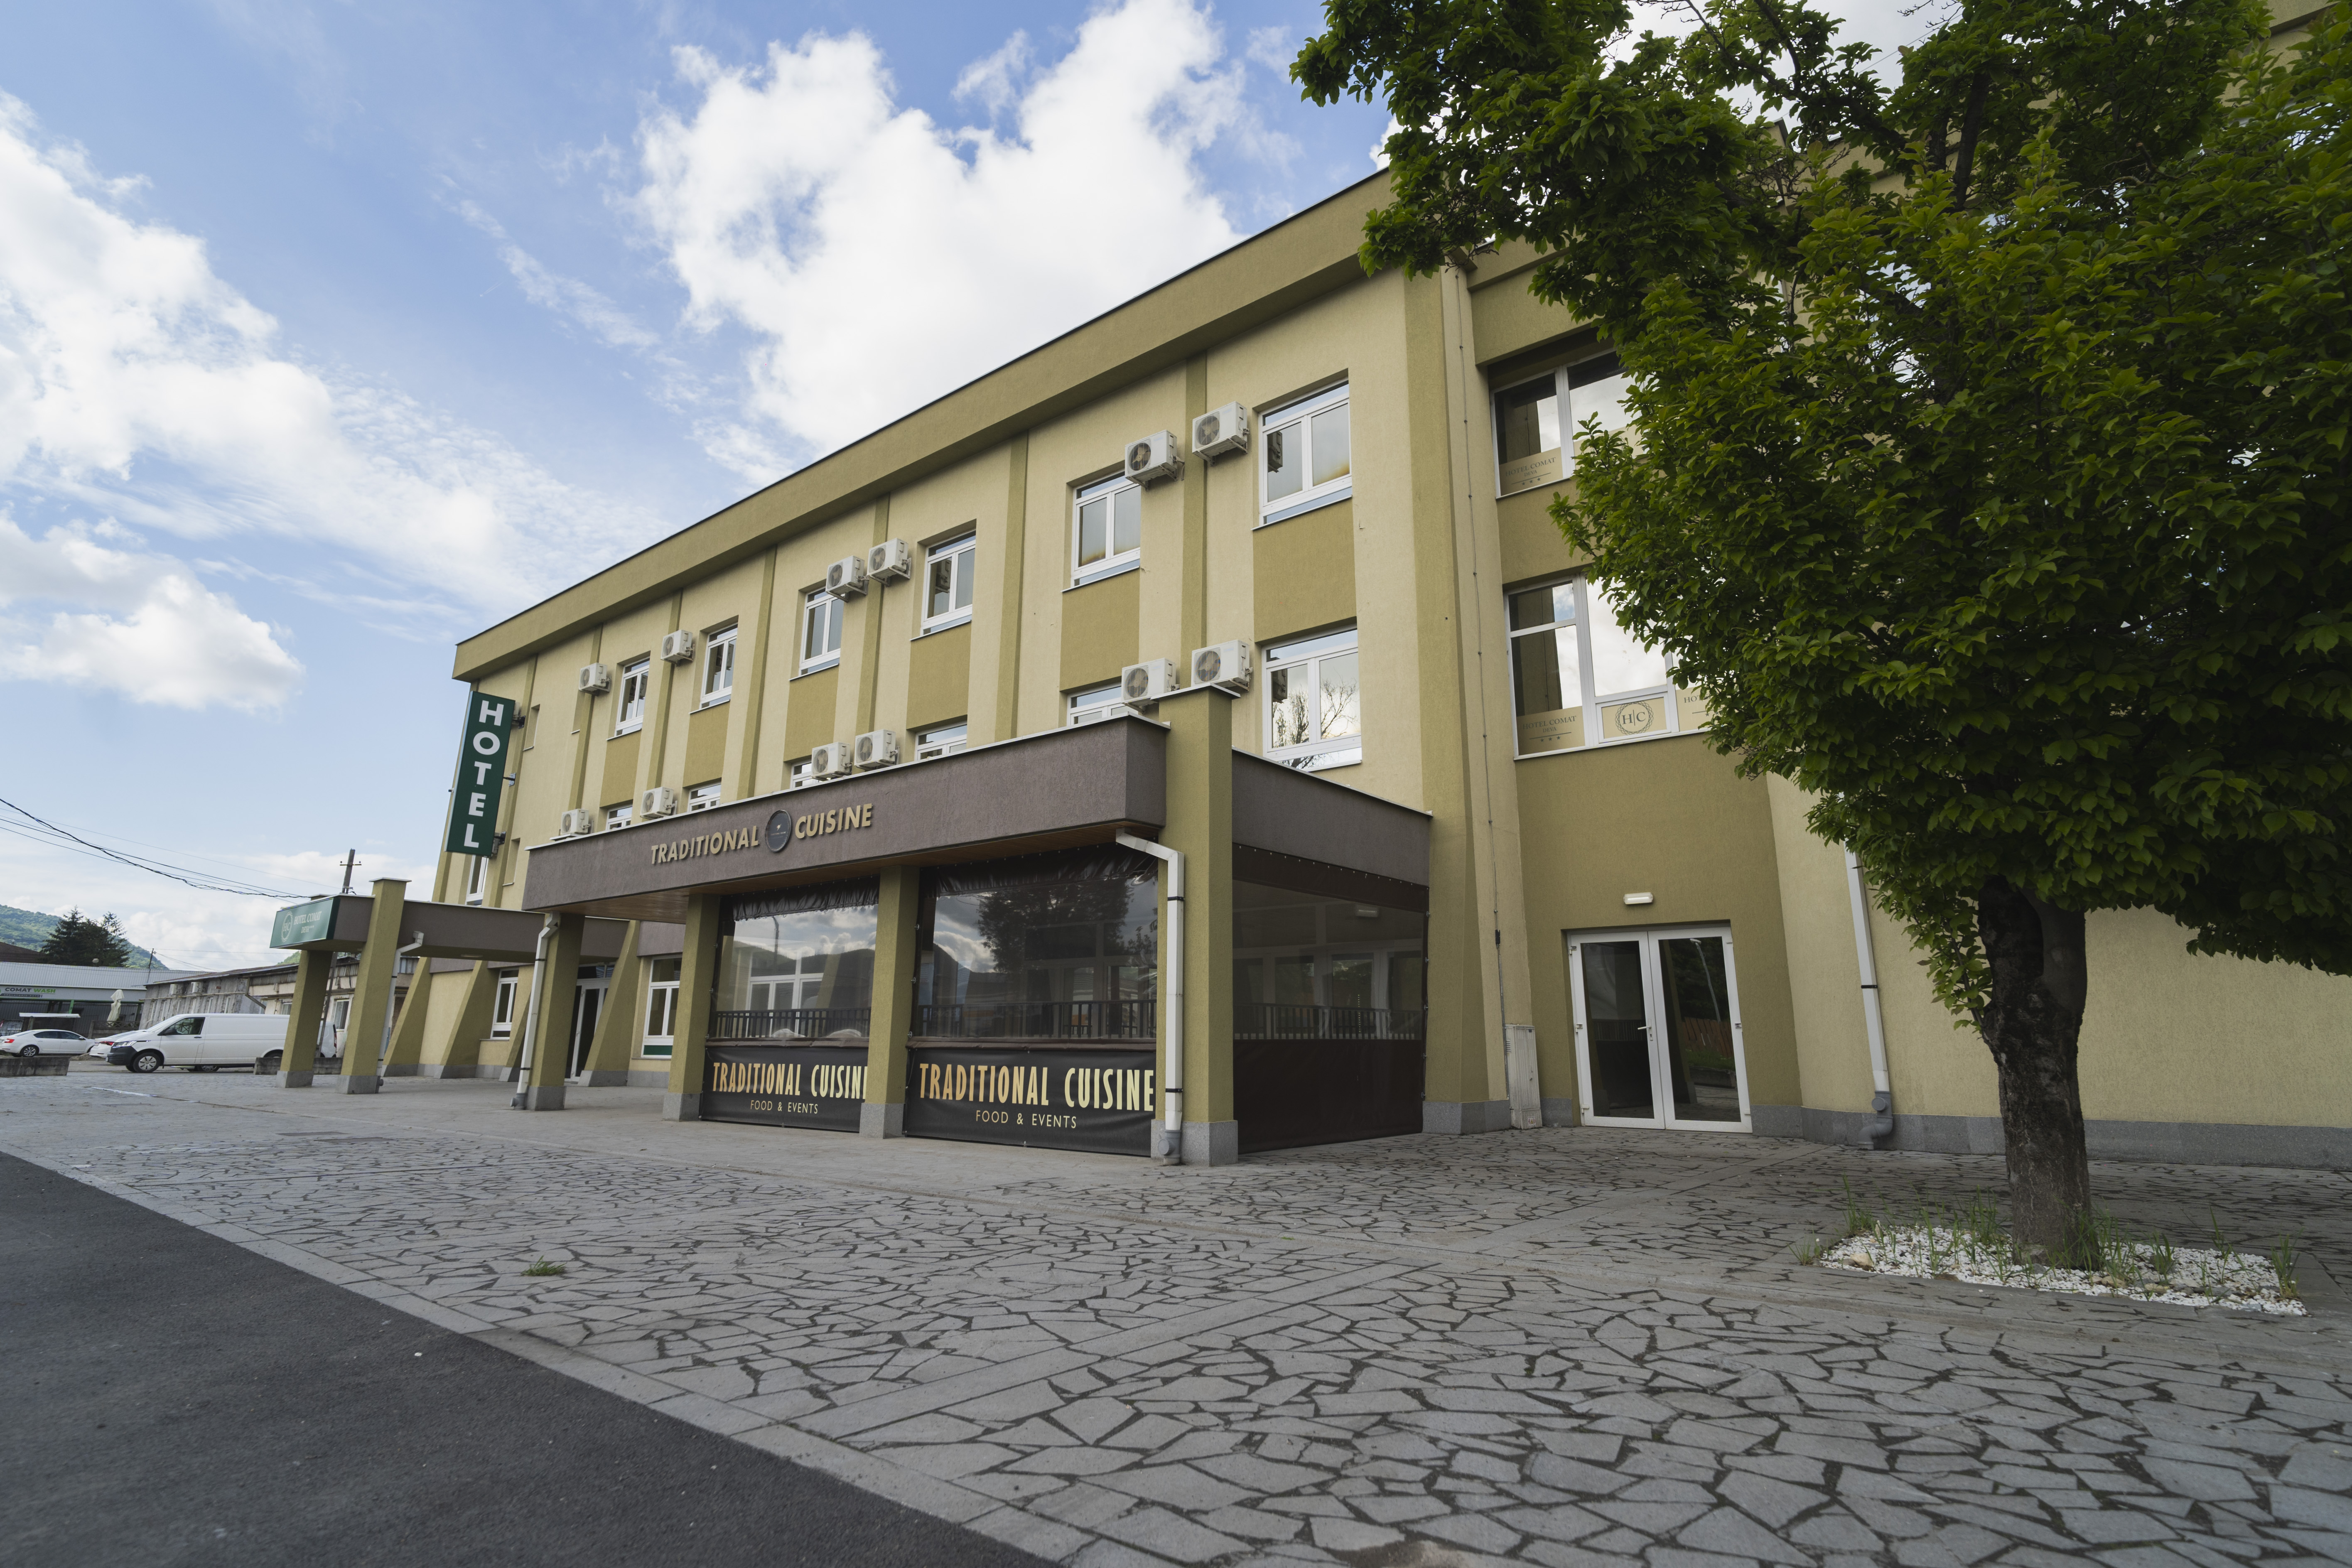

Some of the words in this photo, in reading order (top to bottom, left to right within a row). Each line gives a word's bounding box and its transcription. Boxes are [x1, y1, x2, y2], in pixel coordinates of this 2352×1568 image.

[1505, 466, 1529, 476] HOTEL
[1530, 457, 1556, 469] COMAT
[1523, 721, 1548, 730] HOTEL
[1549, 715, 1577, 725] COMAT
[464, 700, 504, 848] HOTEL
[651, 825, 759, 864] TRADITIONAL
[795, 803, 873, 839] CUISINE
[293, 914, 307, 925] HOTEL
[307, 911, 322, 923] COMAT
[712, 1062, 801, 1096] TRADITIONAL
[919, 1063, 1049, 1106] TRADITIONAL
[1064, 1067, 1154, 1112] CUISINE
[750, 1100, 773, 1111] FOOD
[778, 1102, 782, 1112] &
[788, 1102, 818, 1114] EVENTS
[976, 1110, 1009, 1123] FOOD
[1016, 1113, 1023, 1125] &
[1032, 1114, 1077, 1129] EVENTS
